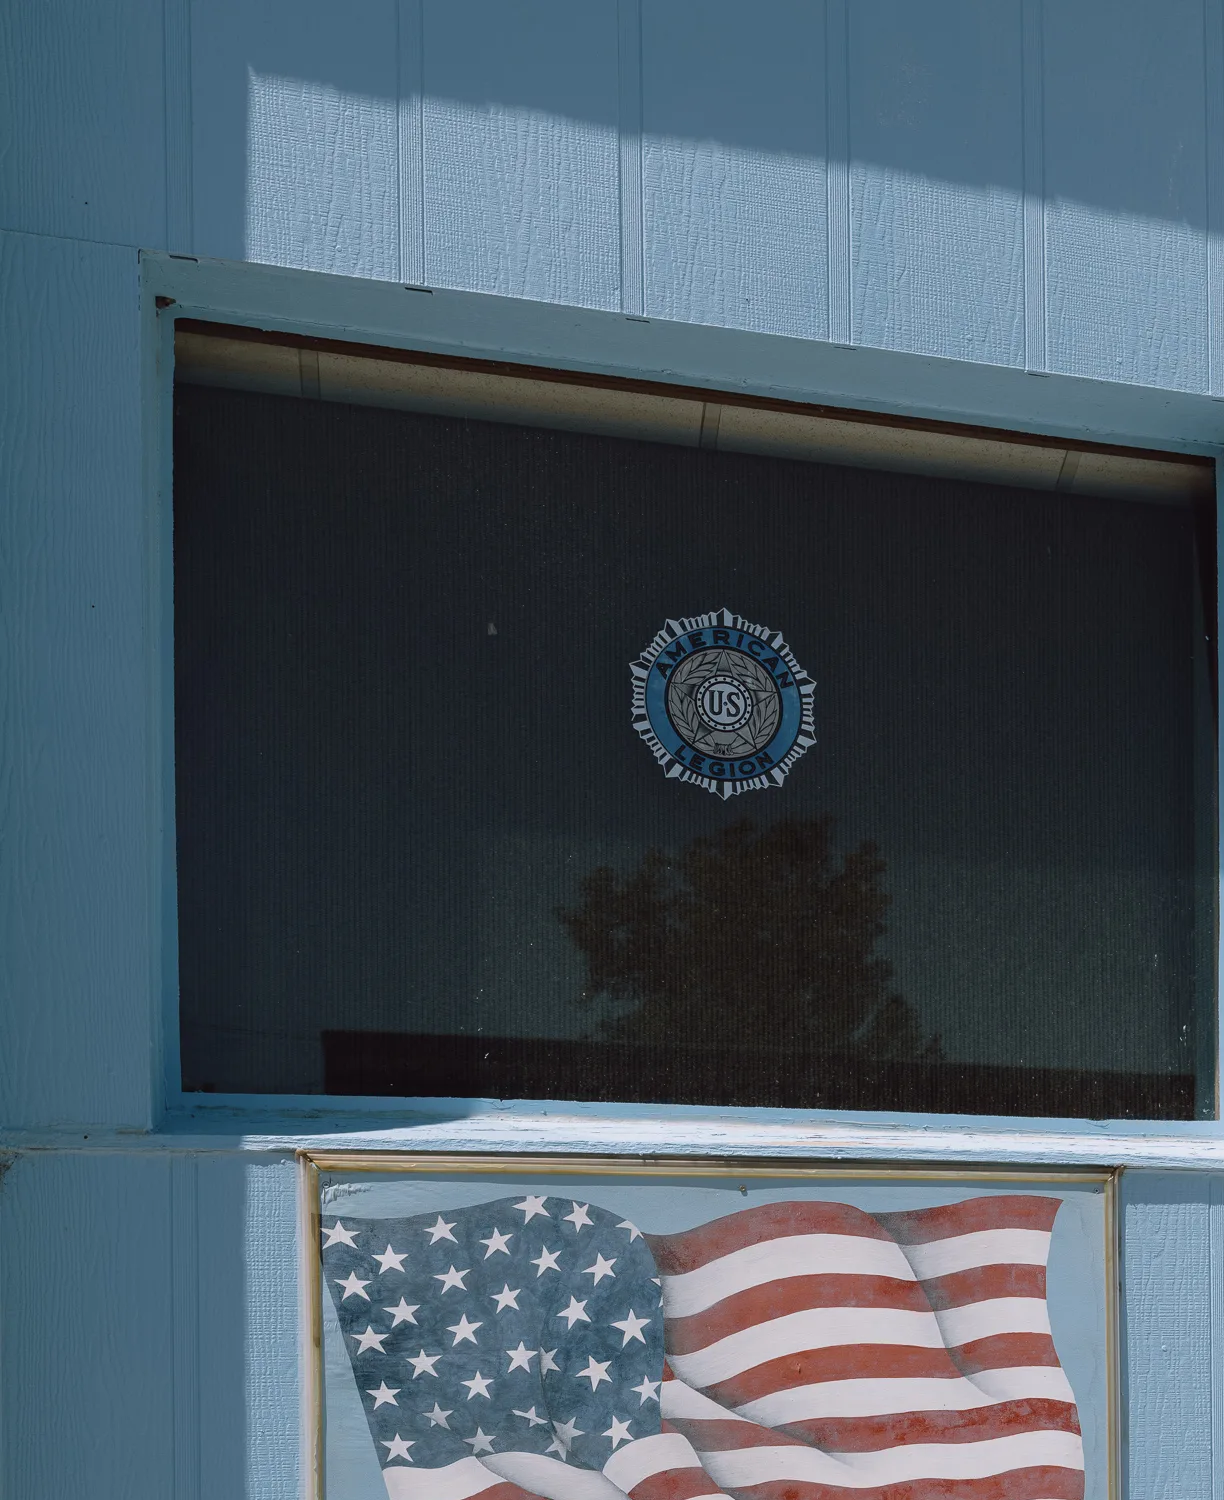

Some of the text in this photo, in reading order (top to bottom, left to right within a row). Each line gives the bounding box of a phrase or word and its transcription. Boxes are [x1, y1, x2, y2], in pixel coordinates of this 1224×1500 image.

[655, 629, 794, 690] AMERICAN
[708, 689, 741, 718] US
[674, 744, 774, 778] LEGION
